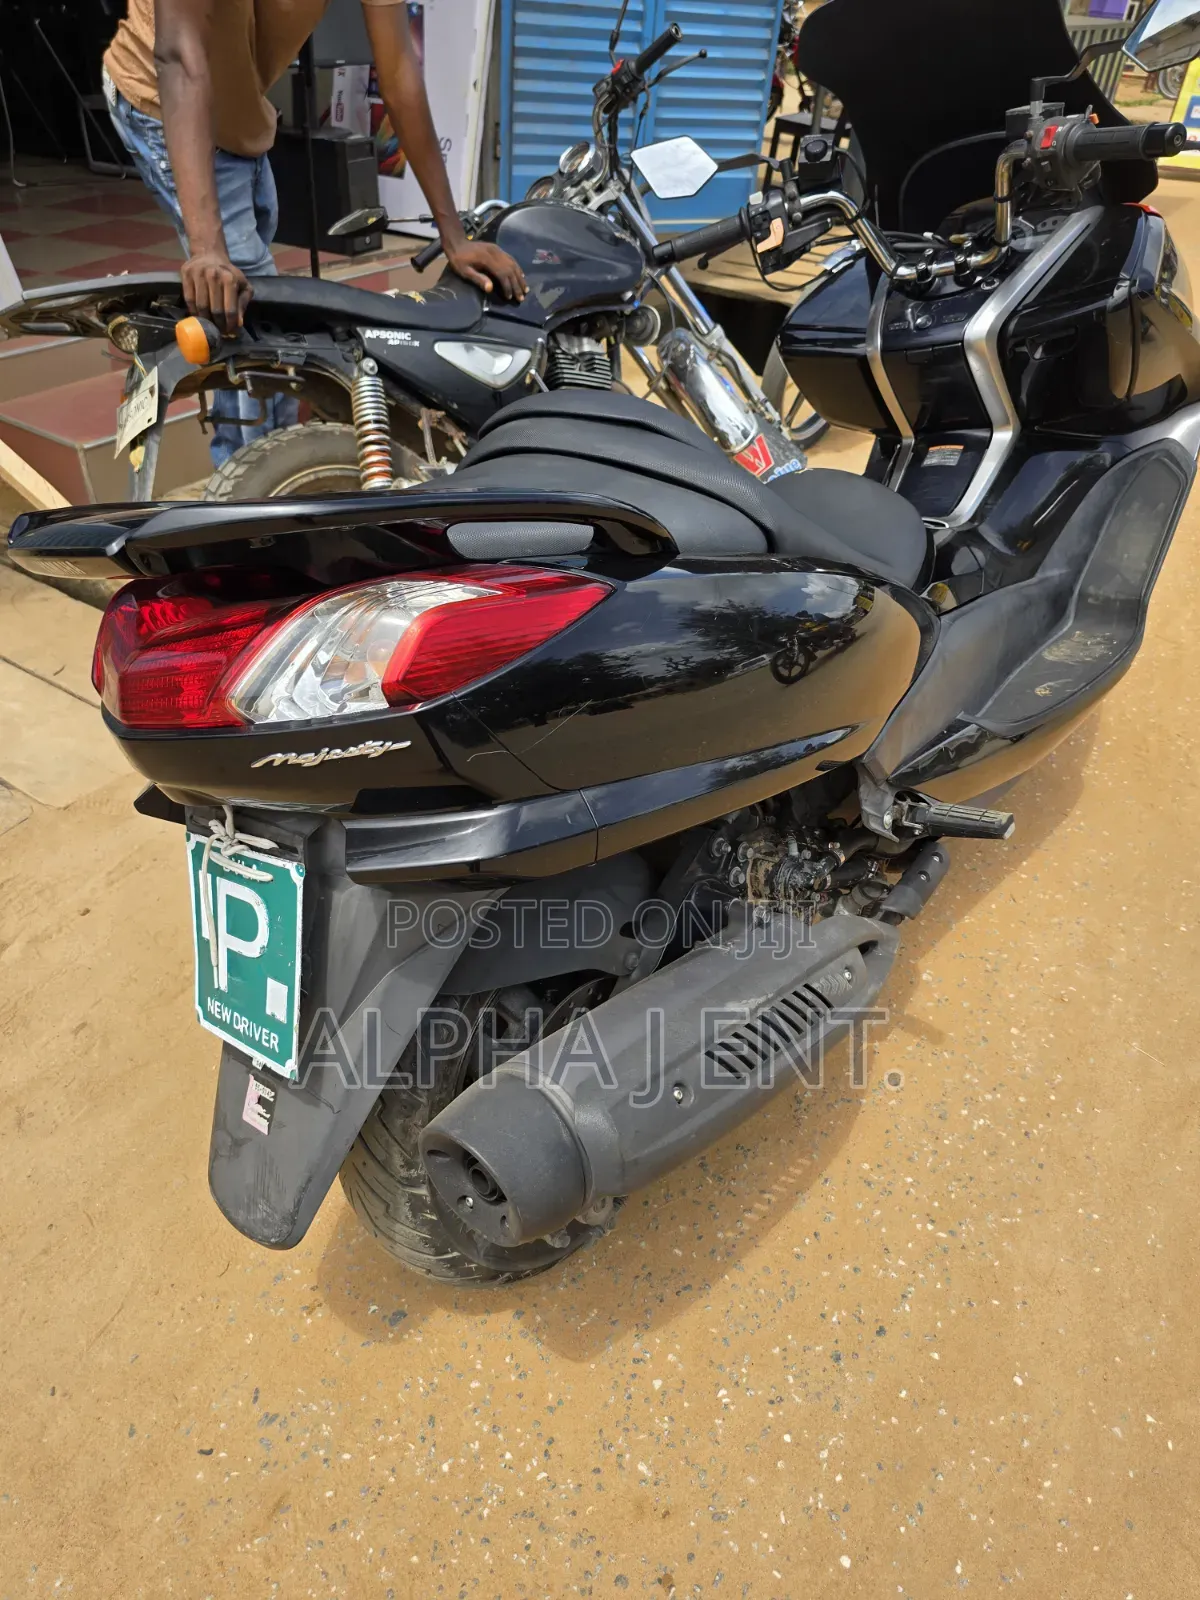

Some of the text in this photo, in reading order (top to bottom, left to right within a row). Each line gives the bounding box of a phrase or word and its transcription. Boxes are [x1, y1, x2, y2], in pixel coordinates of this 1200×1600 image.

[365, 329, 412, 340] APSONIC
[207, 996, 280, 1053] NEW DRIVER
